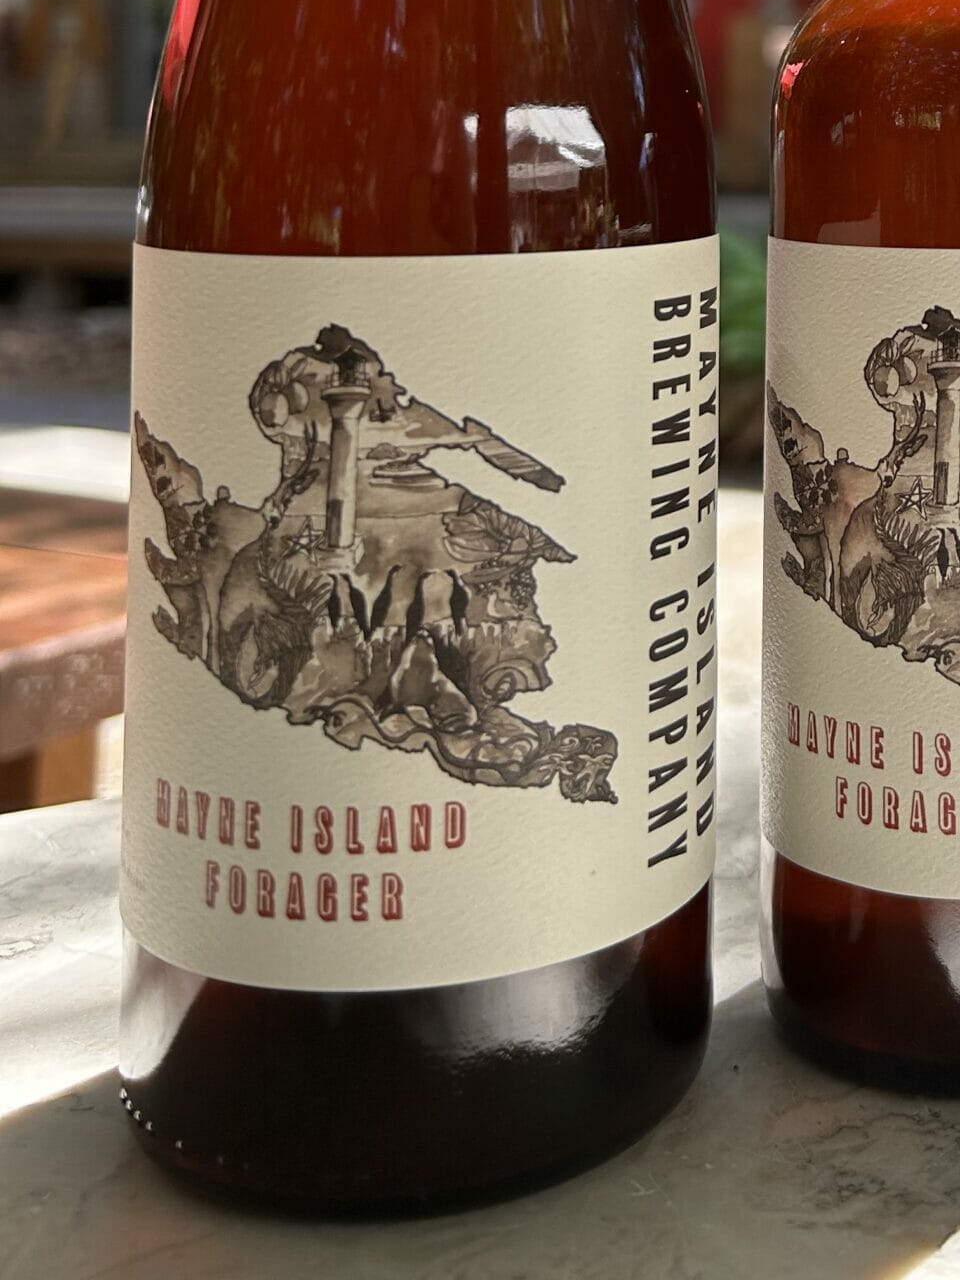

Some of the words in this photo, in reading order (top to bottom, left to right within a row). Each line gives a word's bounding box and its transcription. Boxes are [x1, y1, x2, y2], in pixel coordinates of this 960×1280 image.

[650, 294, 692, 560] BREWING
[697, 286, 718, 524] MAYNE
[156, 777, 261, 850] MAYNE
[290, 800, 467, 855] ISLAND
[647, 589, 690, 869] COMPANY
[696, 561, 716, 837] ISLAND
[786, 702, 885, 770] MAYNE
[205, 860, 404, 922] FORAGER
